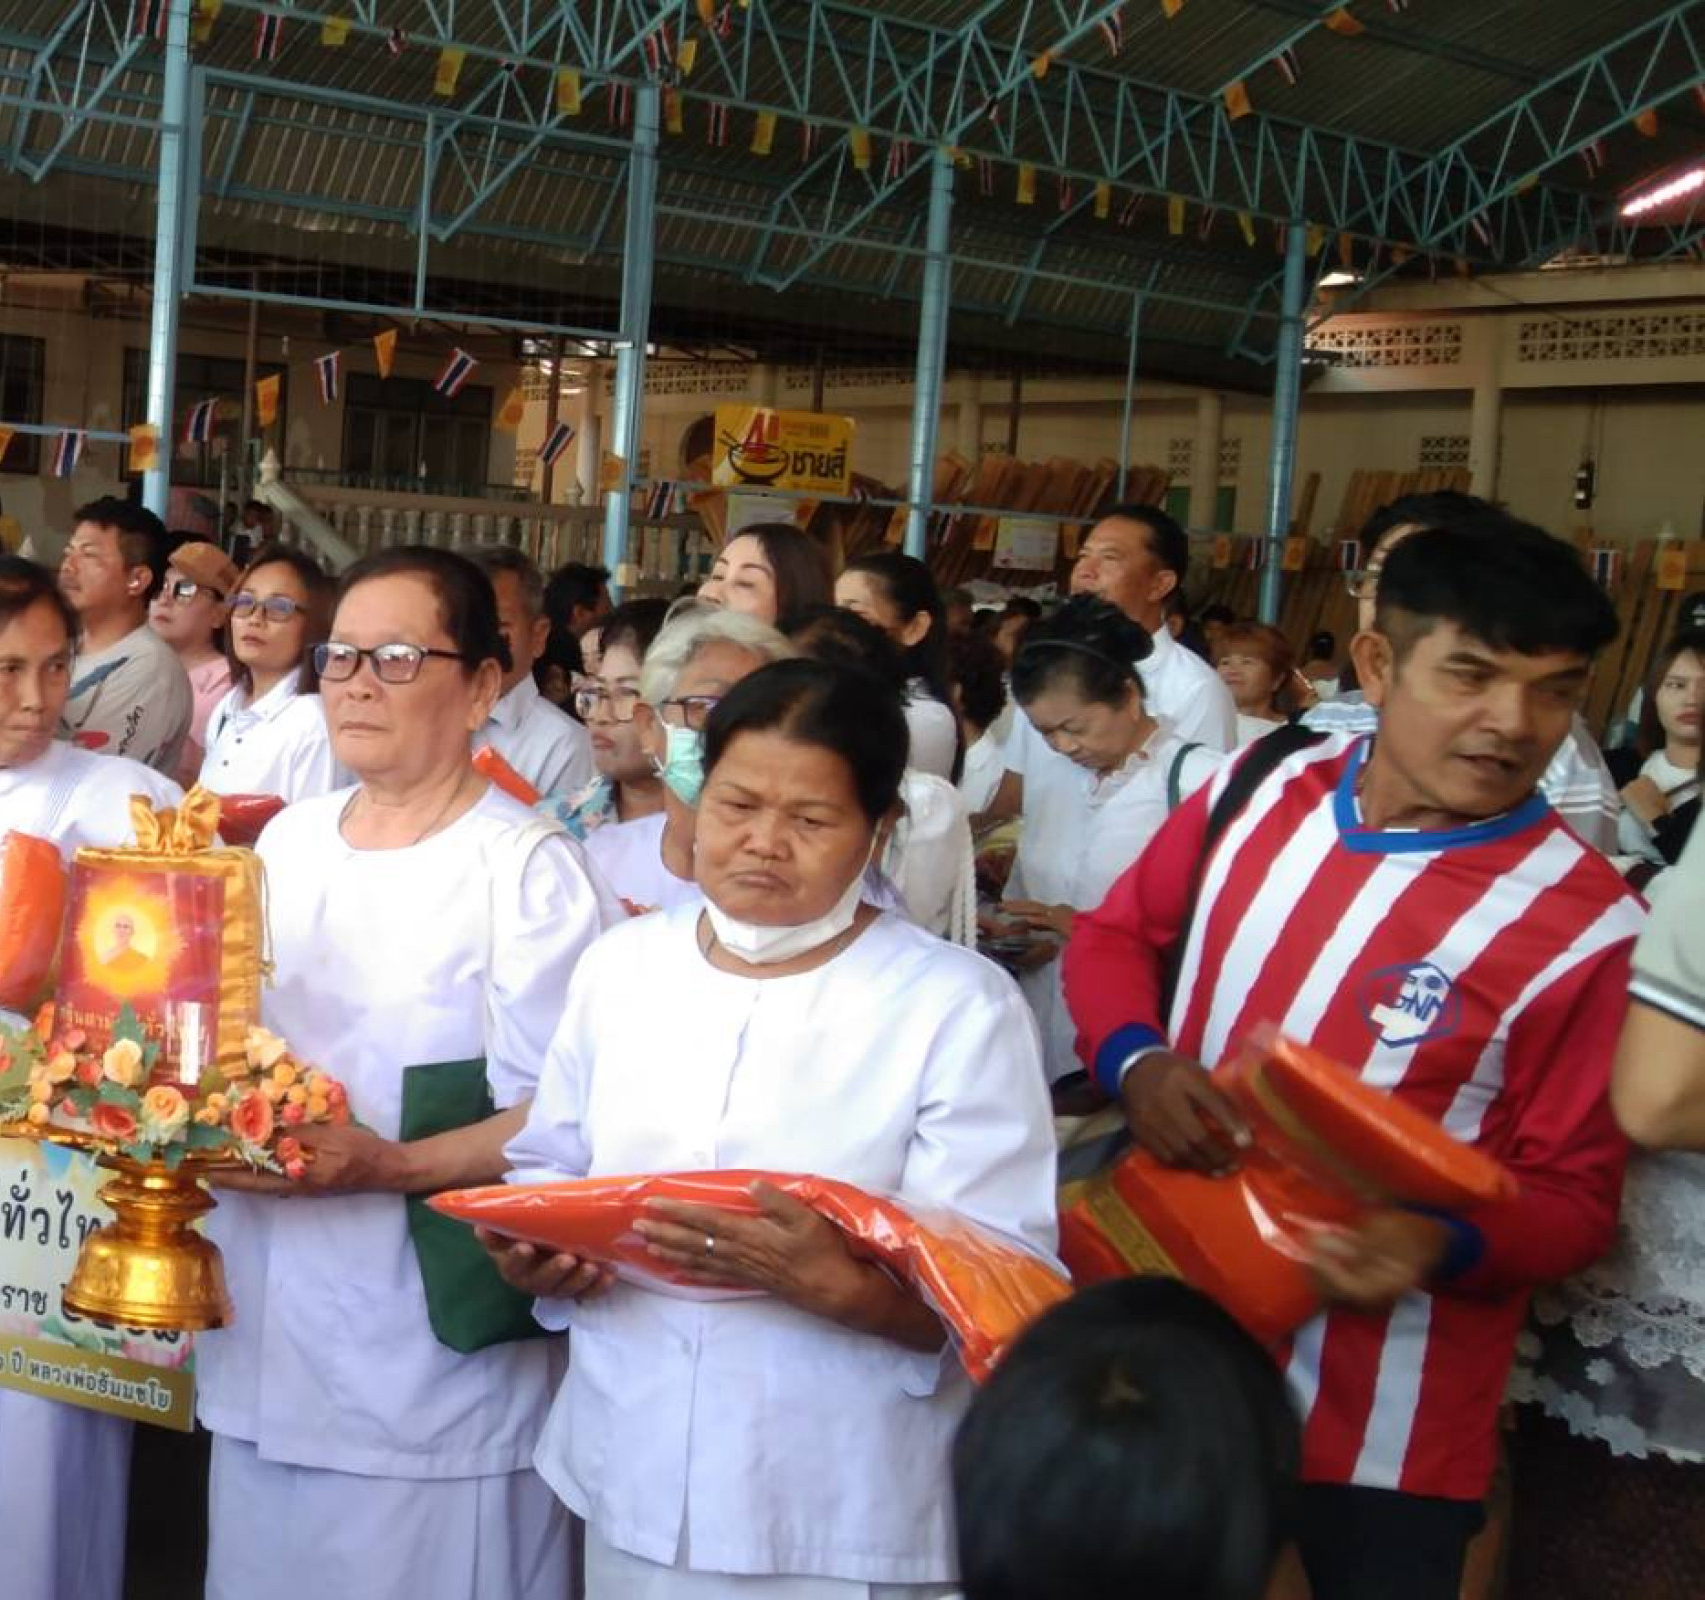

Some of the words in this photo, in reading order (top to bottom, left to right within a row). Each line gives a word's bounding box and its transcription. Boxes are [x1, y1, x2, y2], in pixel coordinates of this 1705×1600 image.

[791, 440, 846, 479] ชายสี่
[10, 1346, 26, 1376] ปี
[29, 1357, 173, 1412] หลวงพ่อธัมมชโย
